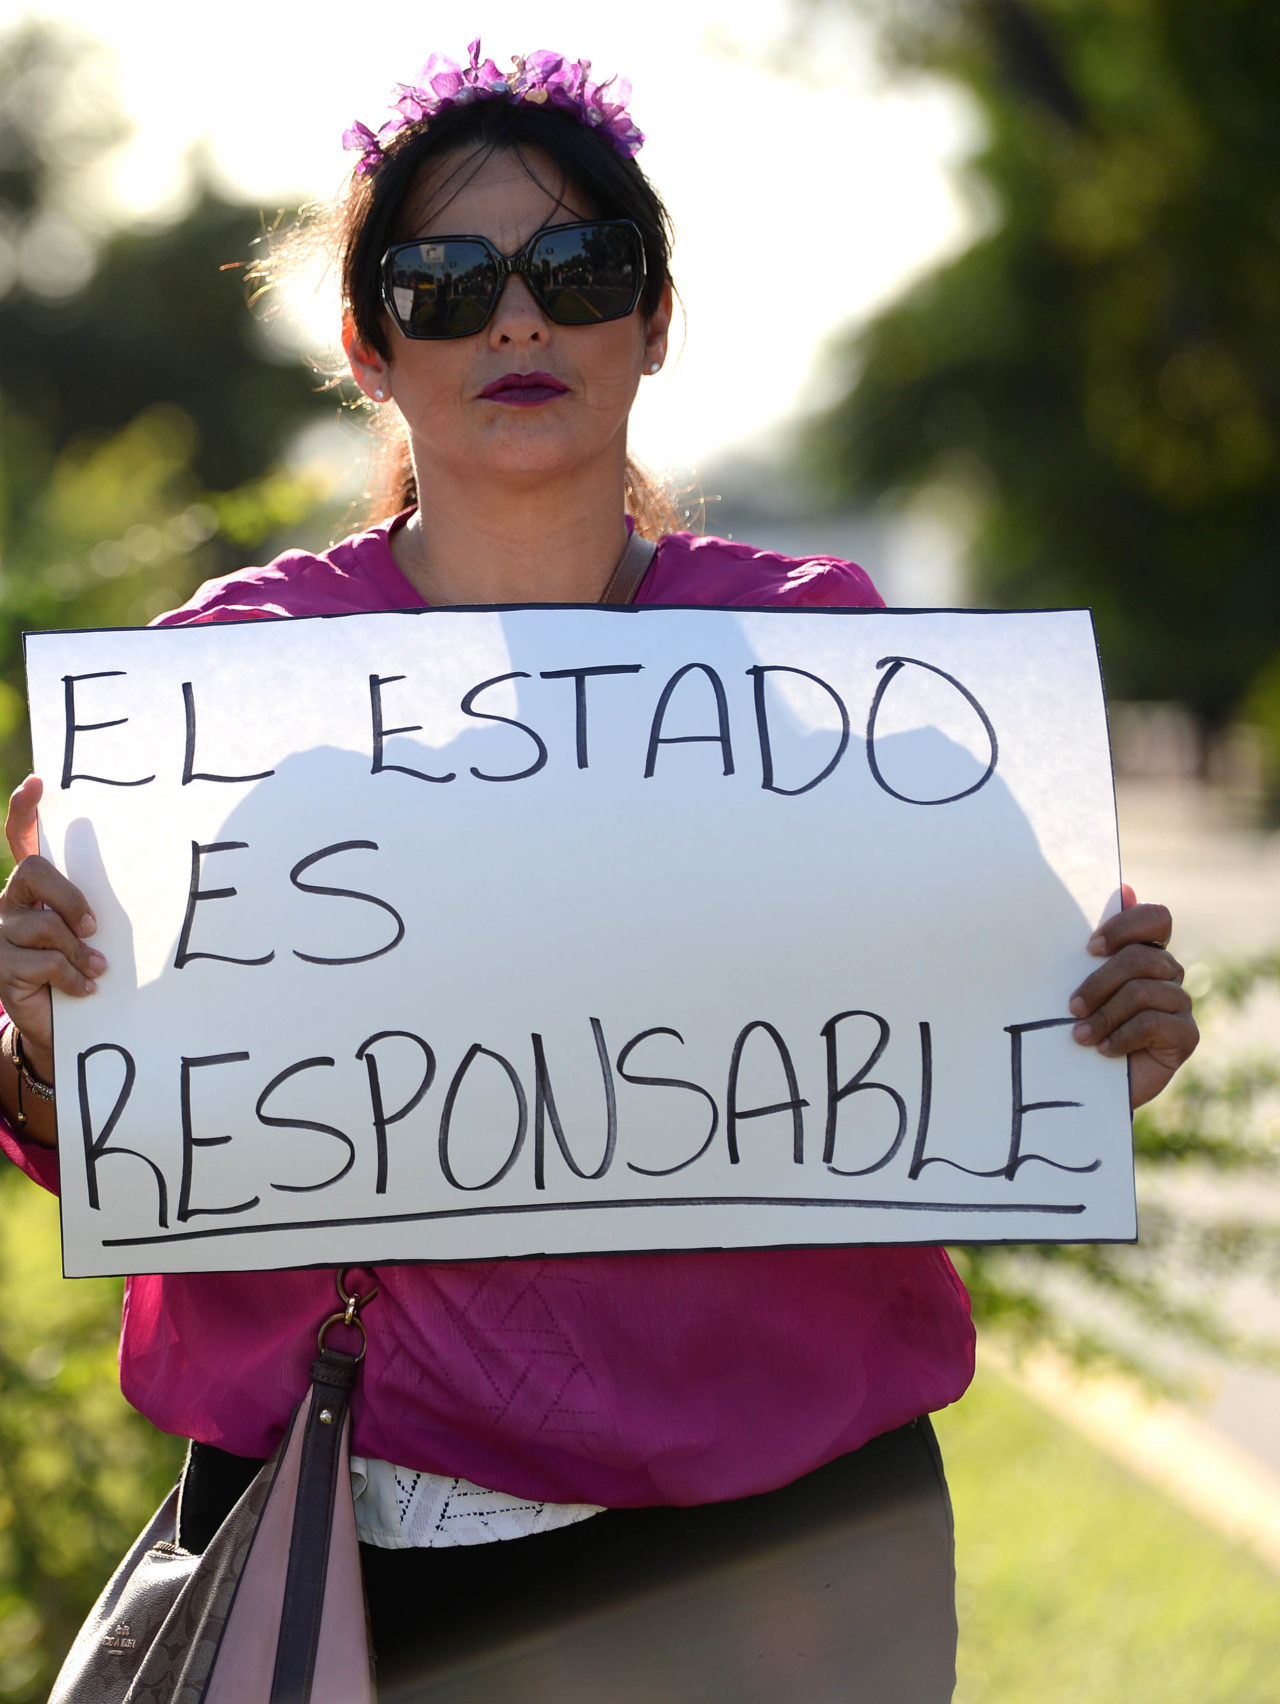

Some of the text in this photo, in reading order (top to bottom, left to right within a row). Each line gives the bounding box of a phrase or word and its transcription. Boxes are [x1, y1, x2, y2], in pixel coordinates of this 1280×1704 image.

[62, 656, 999, 805] EL ESTADO
[174, 838, 406, 970] ES
[77, 1010, 1102, 1228] RESPONSABLE
